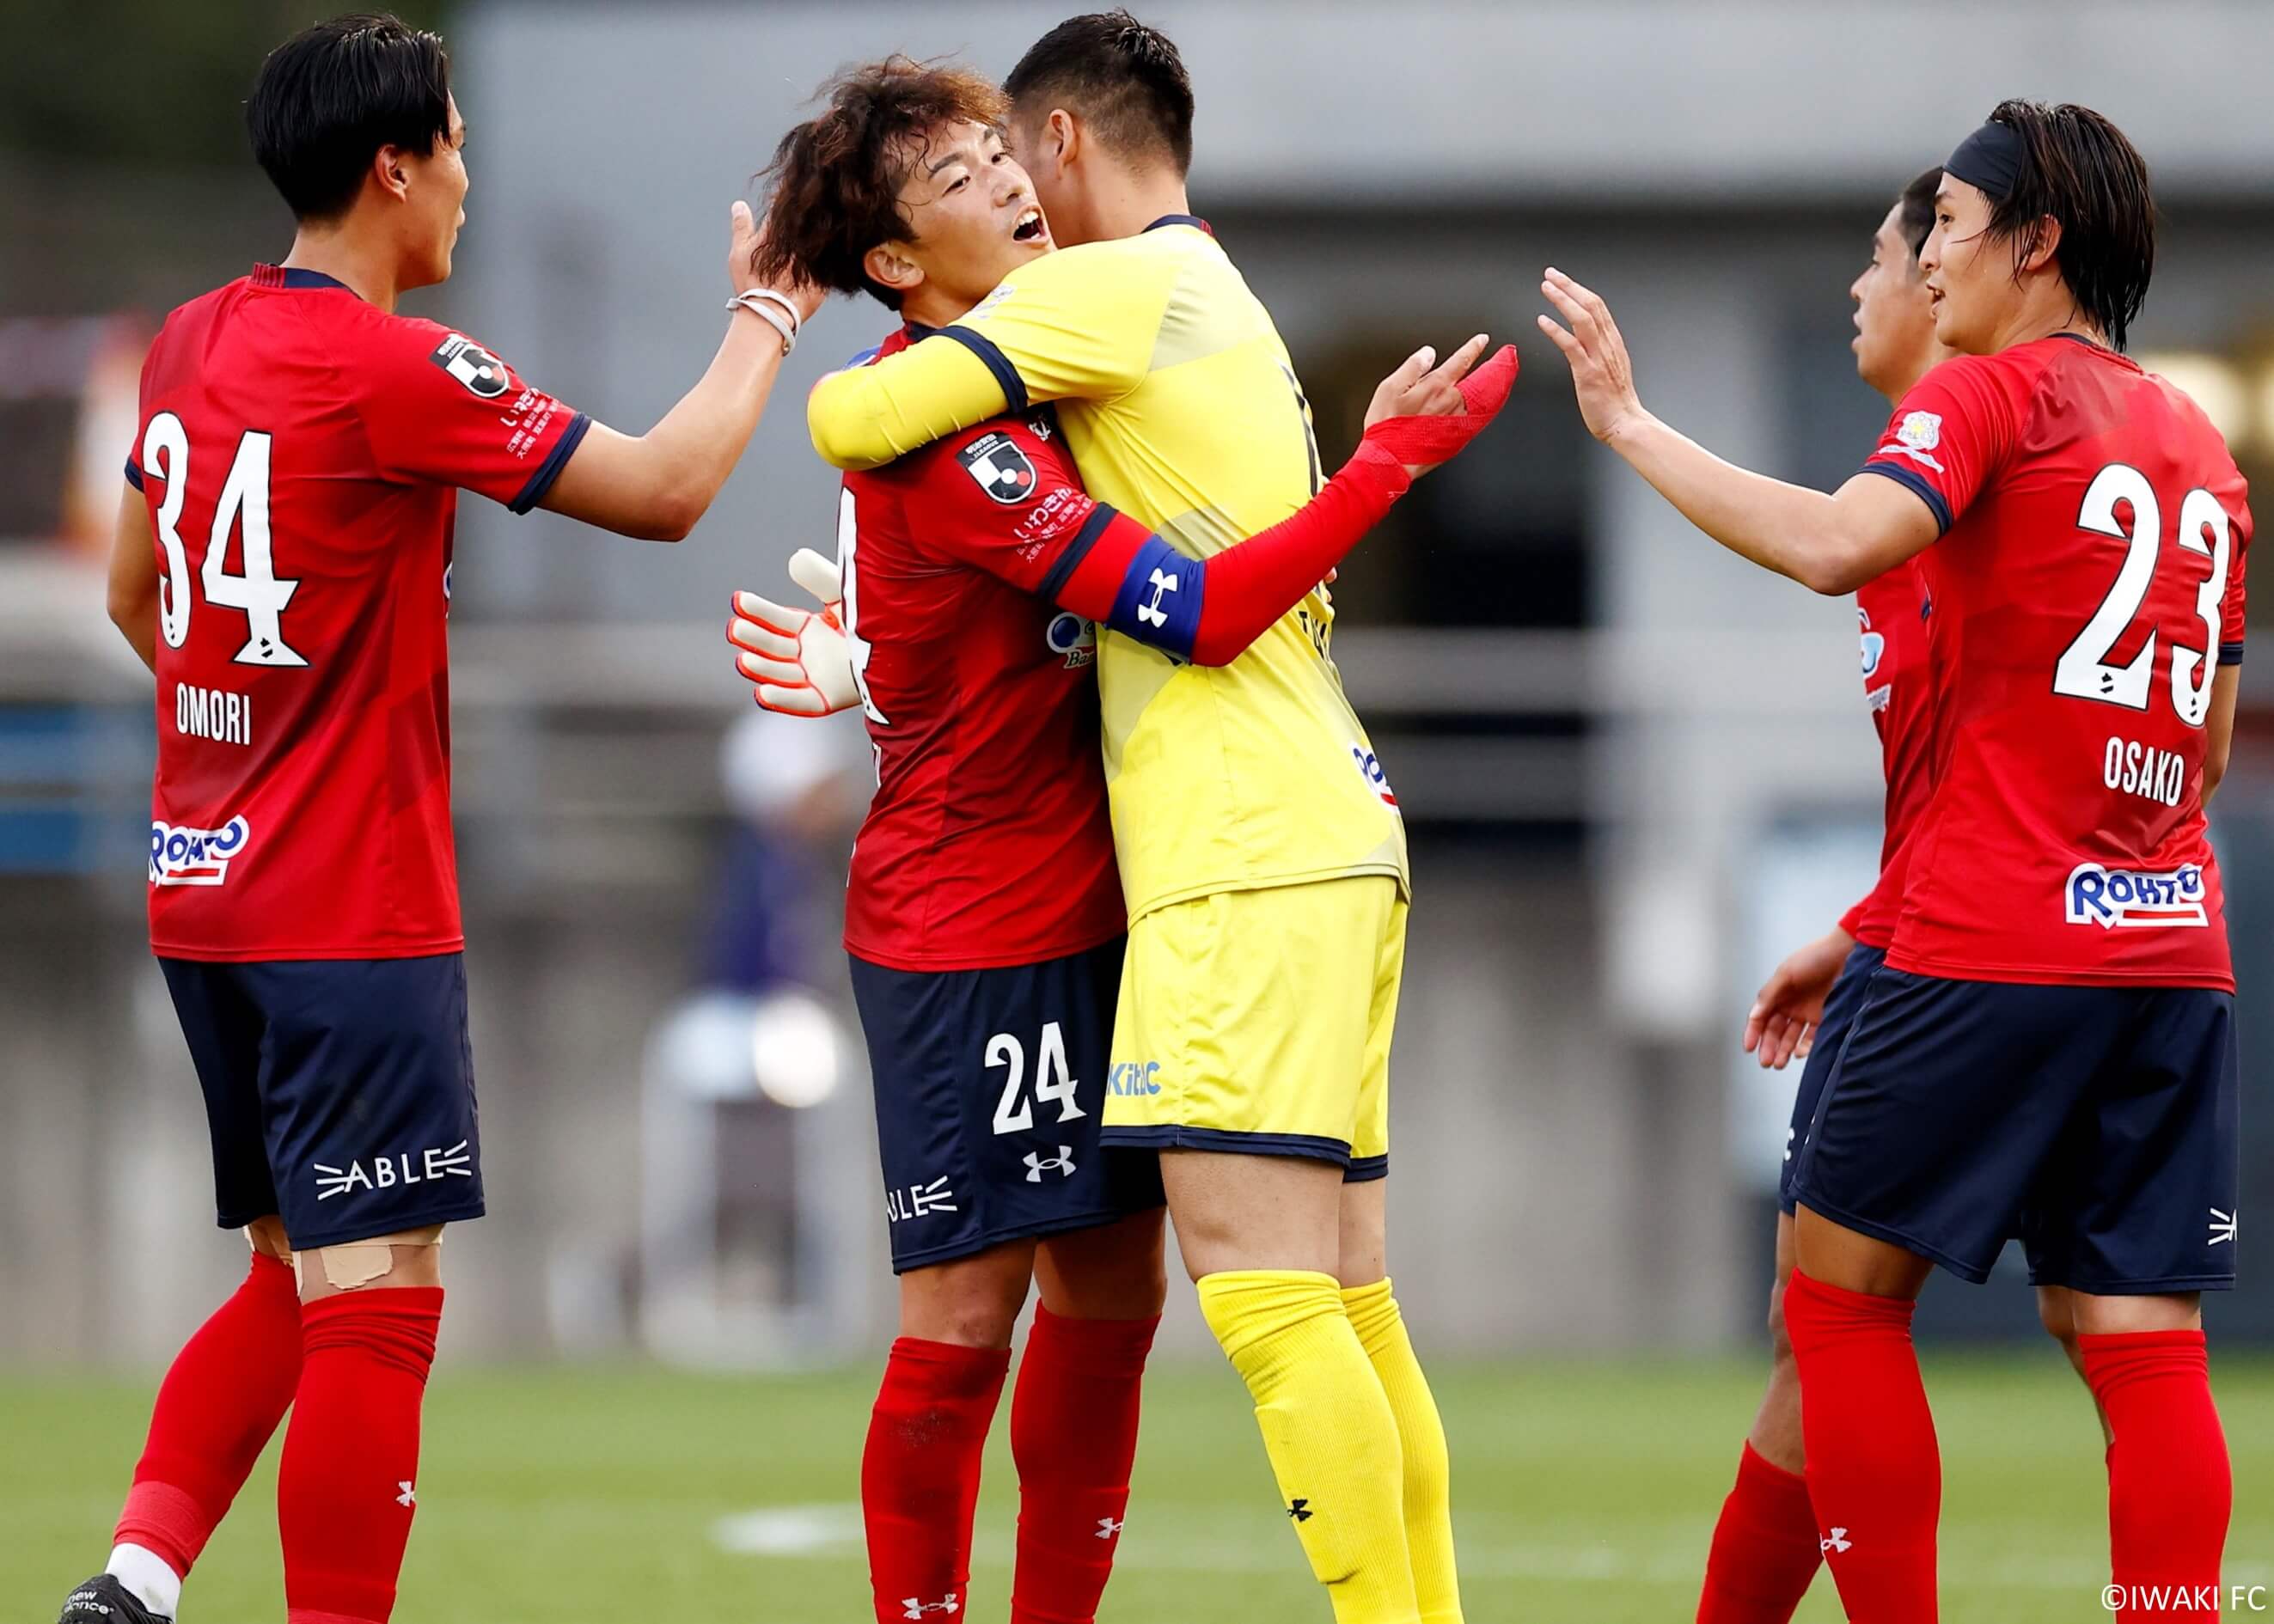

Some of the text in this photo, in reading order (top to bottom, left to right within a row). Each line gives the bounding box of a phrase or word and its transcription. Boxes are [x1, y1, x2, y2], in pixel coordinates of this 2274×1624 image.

[143, 411, 309, 668] 34
[2051, 463, 2229, 728] 23
[175, 681, 250, 746] OMORI
[2104, 736, 2185, 808] OSAKO
[2069, 866, 2202, 921] ROHTO
[985, 1021, 1086, 1134] 24
[318, 1146, 469, 1195] ABLE
